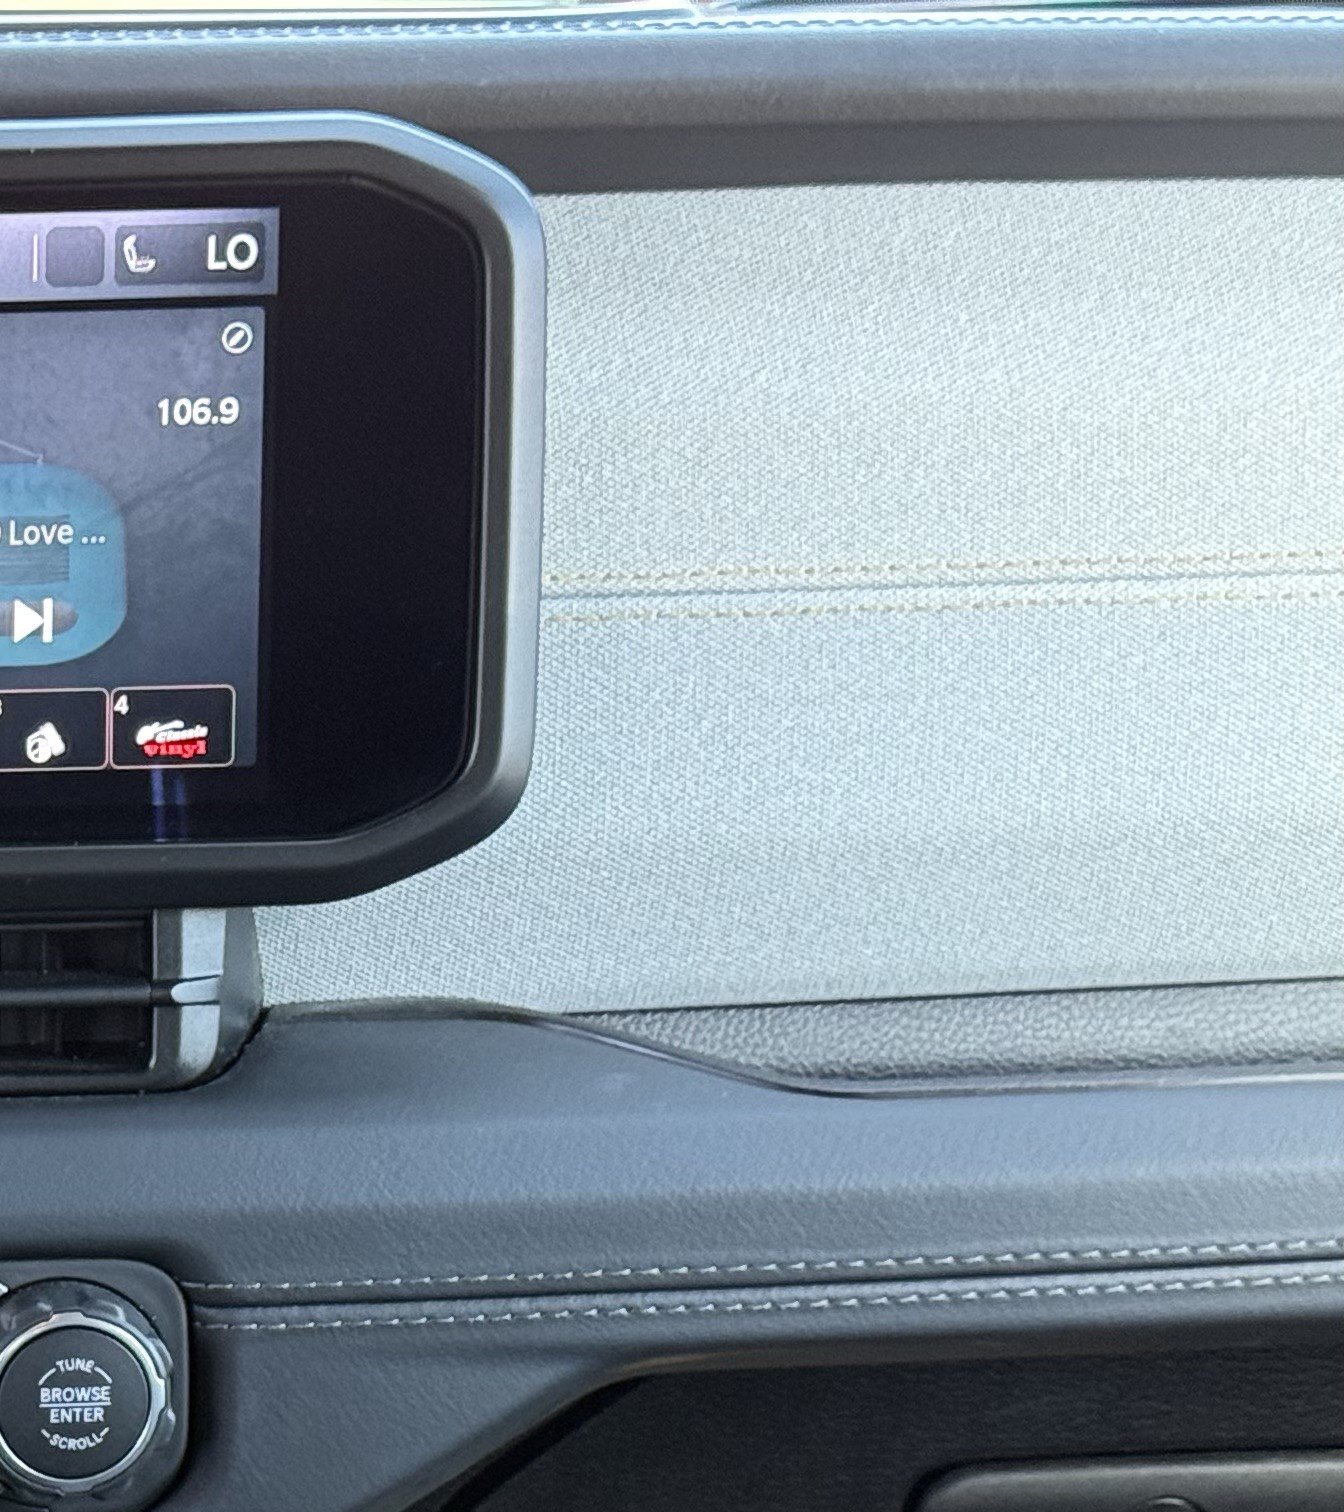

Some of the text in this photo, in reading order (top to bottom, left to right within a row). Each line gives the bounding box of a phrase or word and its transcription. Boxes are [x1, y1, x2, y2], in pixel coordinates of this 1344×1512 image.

[206, 232, 259, 271] LO
[157, 396, 240, 426] 106.9
[9, 520, 75, 546] Love
[113, 694, 129, 716] 4
[55, 1357, 95, 1374] TUNE
[40, 1386, 112, 1403] BROWSE
[49, 1406, 105, 1424] ENTER
[49, 1433, 104, 1451] SCROLL
